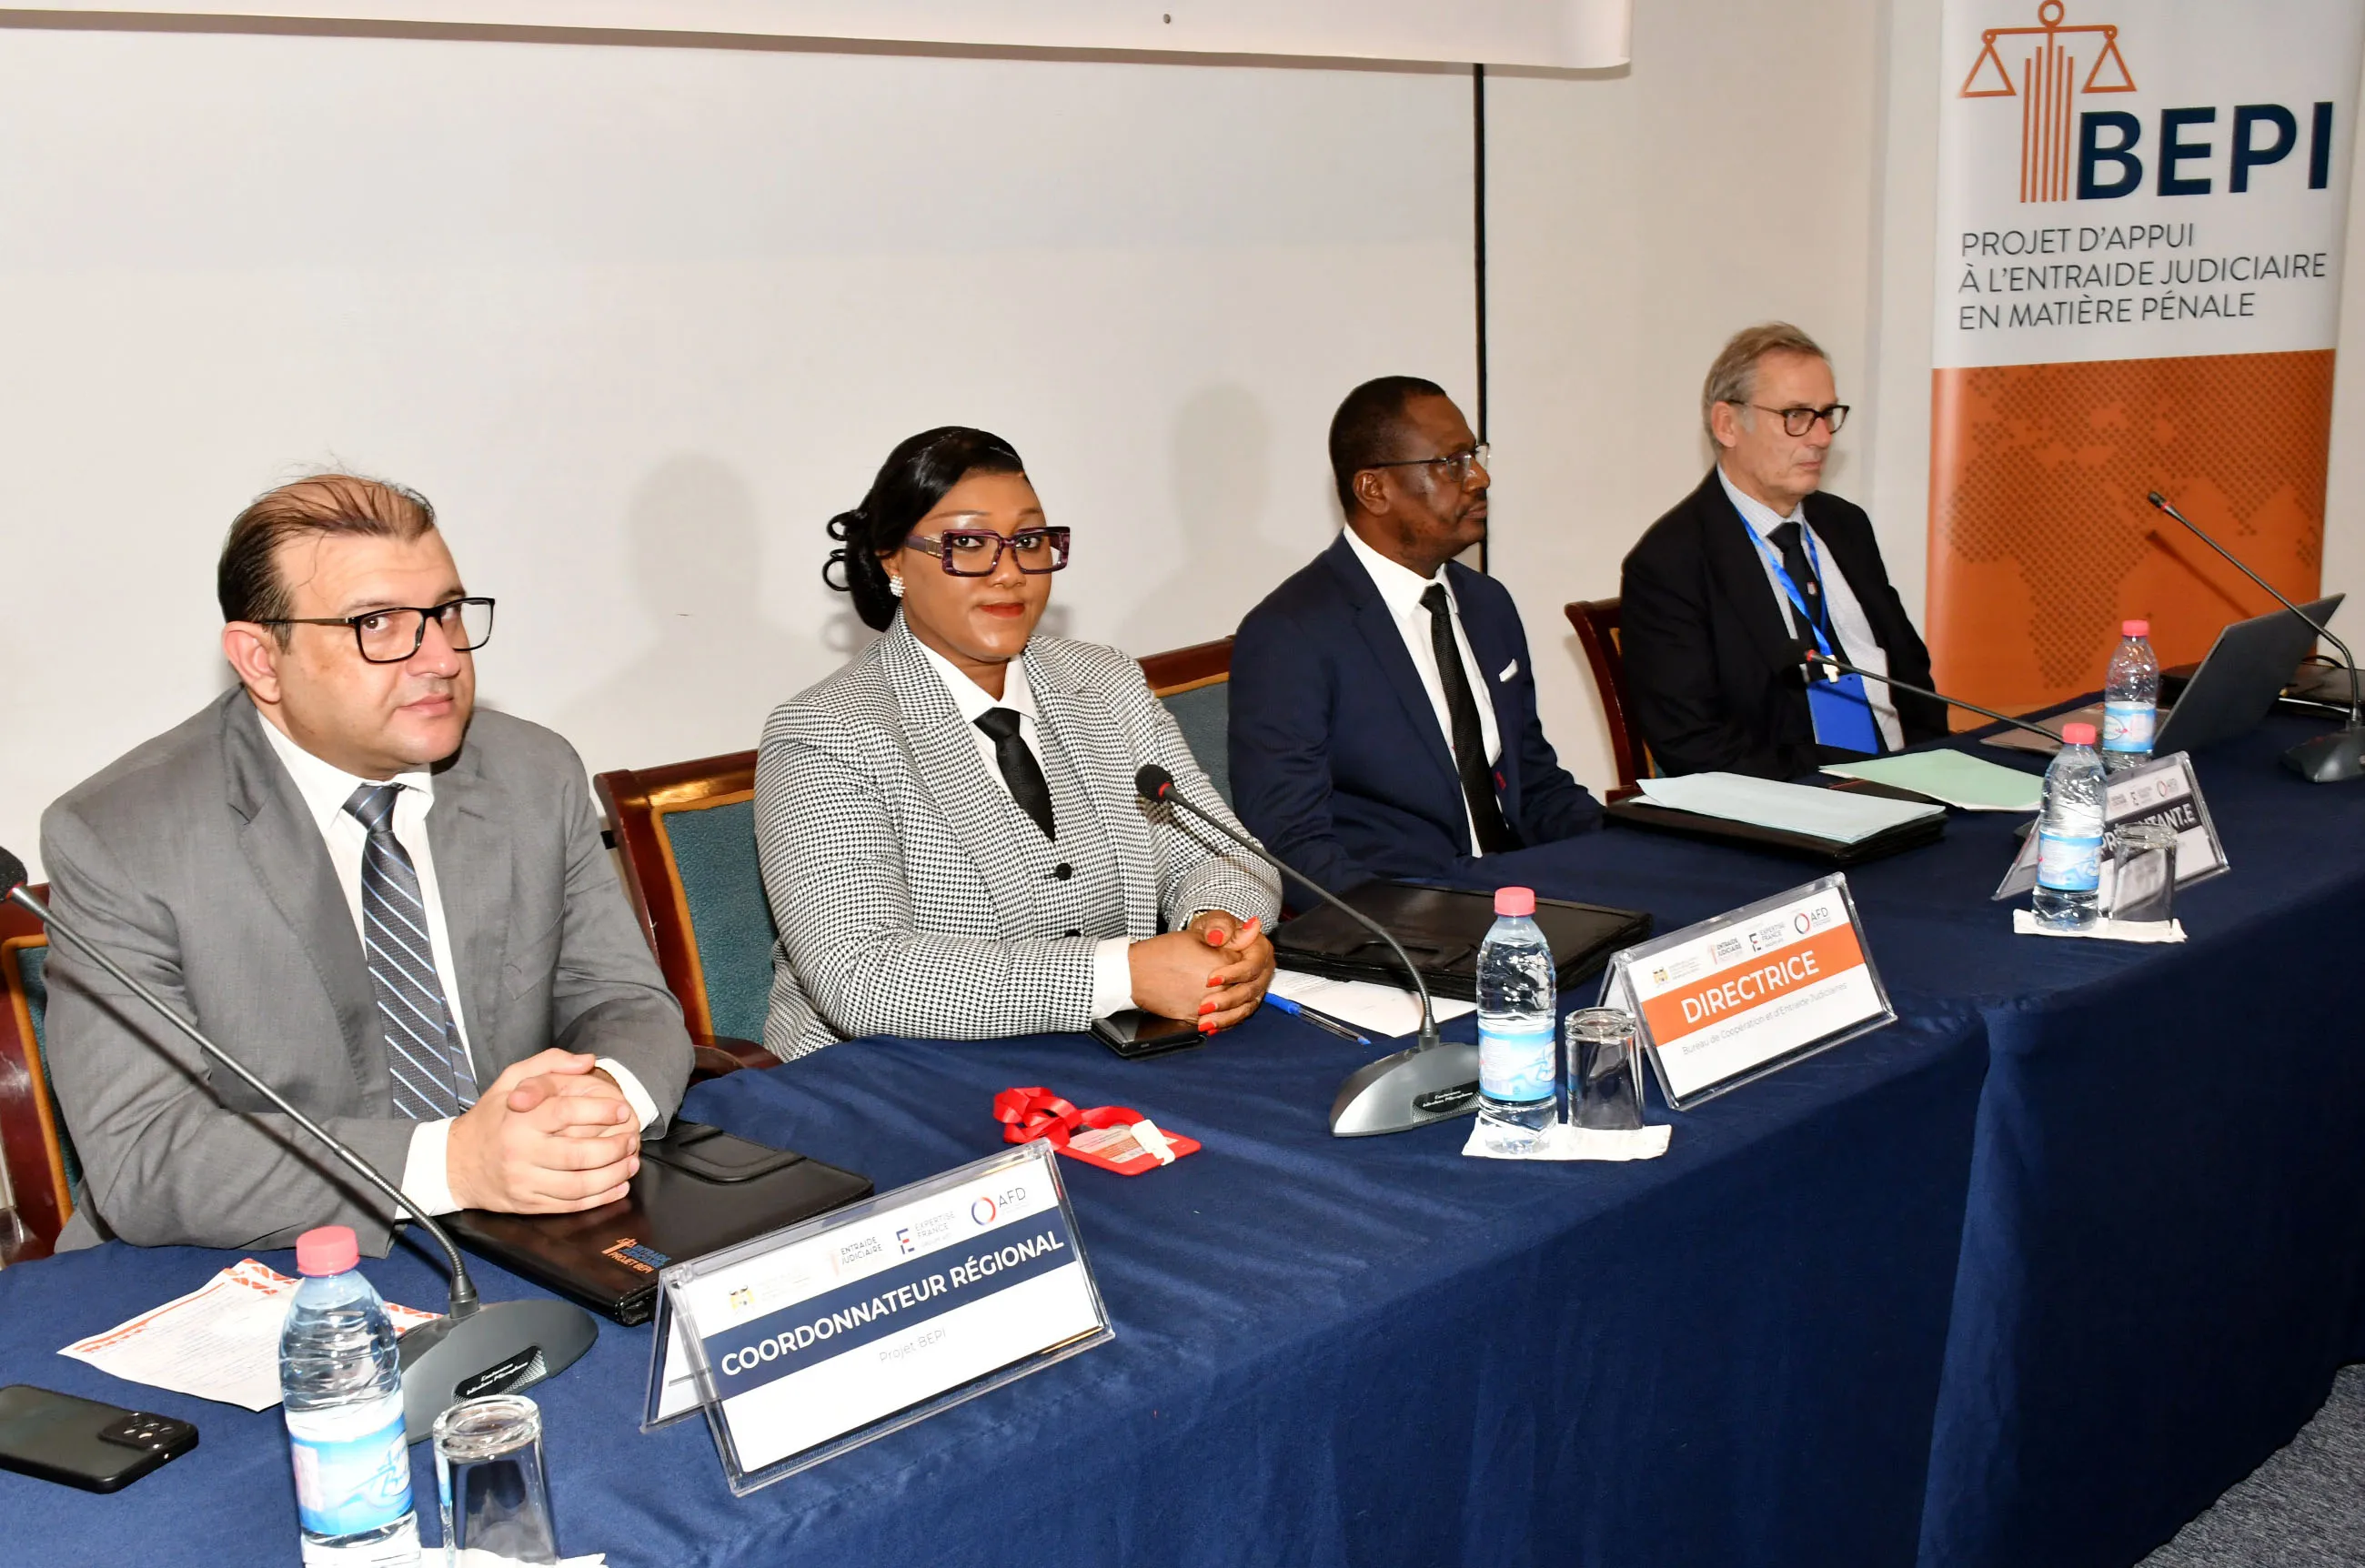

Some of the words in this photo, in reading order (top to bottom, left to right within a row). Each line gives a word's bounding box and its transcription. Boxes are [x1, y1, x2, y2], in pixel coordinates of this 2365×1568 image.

[2077, 102, 2333, 200] BEPI
[1962, 228, 2072, 256] PROJET
[2078, 223, 2194, 252] D’APPUI
[1958, 264, 1979, 294] À
[1989, 261, 2155, 292] L’ENTRAIDE
[2160, 253, 2328, 286] JUDICIAIRE
[1960, 305, 1999, 330] EN
[2008, 294, 2132, 327] MATIÈRE
[2141, 290, 2256, 321] PÉNALE
[1810, 907, 1828, 922] AFD
[1680, 950, 1819, 1024] DIRECTRICE
[1682, 1040, 1709, 1055] Bureau
[1710, 1034, 1720, 1045] de
[999, 1187, 1026, 1208] AFD
[840, 1236, 878, 1256] ENTRAIDE
[917, 1222, 950, 1239] FRANCE
[841, 1244, 883, 1266] JUDICIAIRE
[721, 1276, 947, 1376] COORDONNATEUR
[950, 1231, 1064, 1288] RÉGIONAL
[880, 1341, 916, 1363] Projet
[919, 1328, 947, 1348] BEPI
